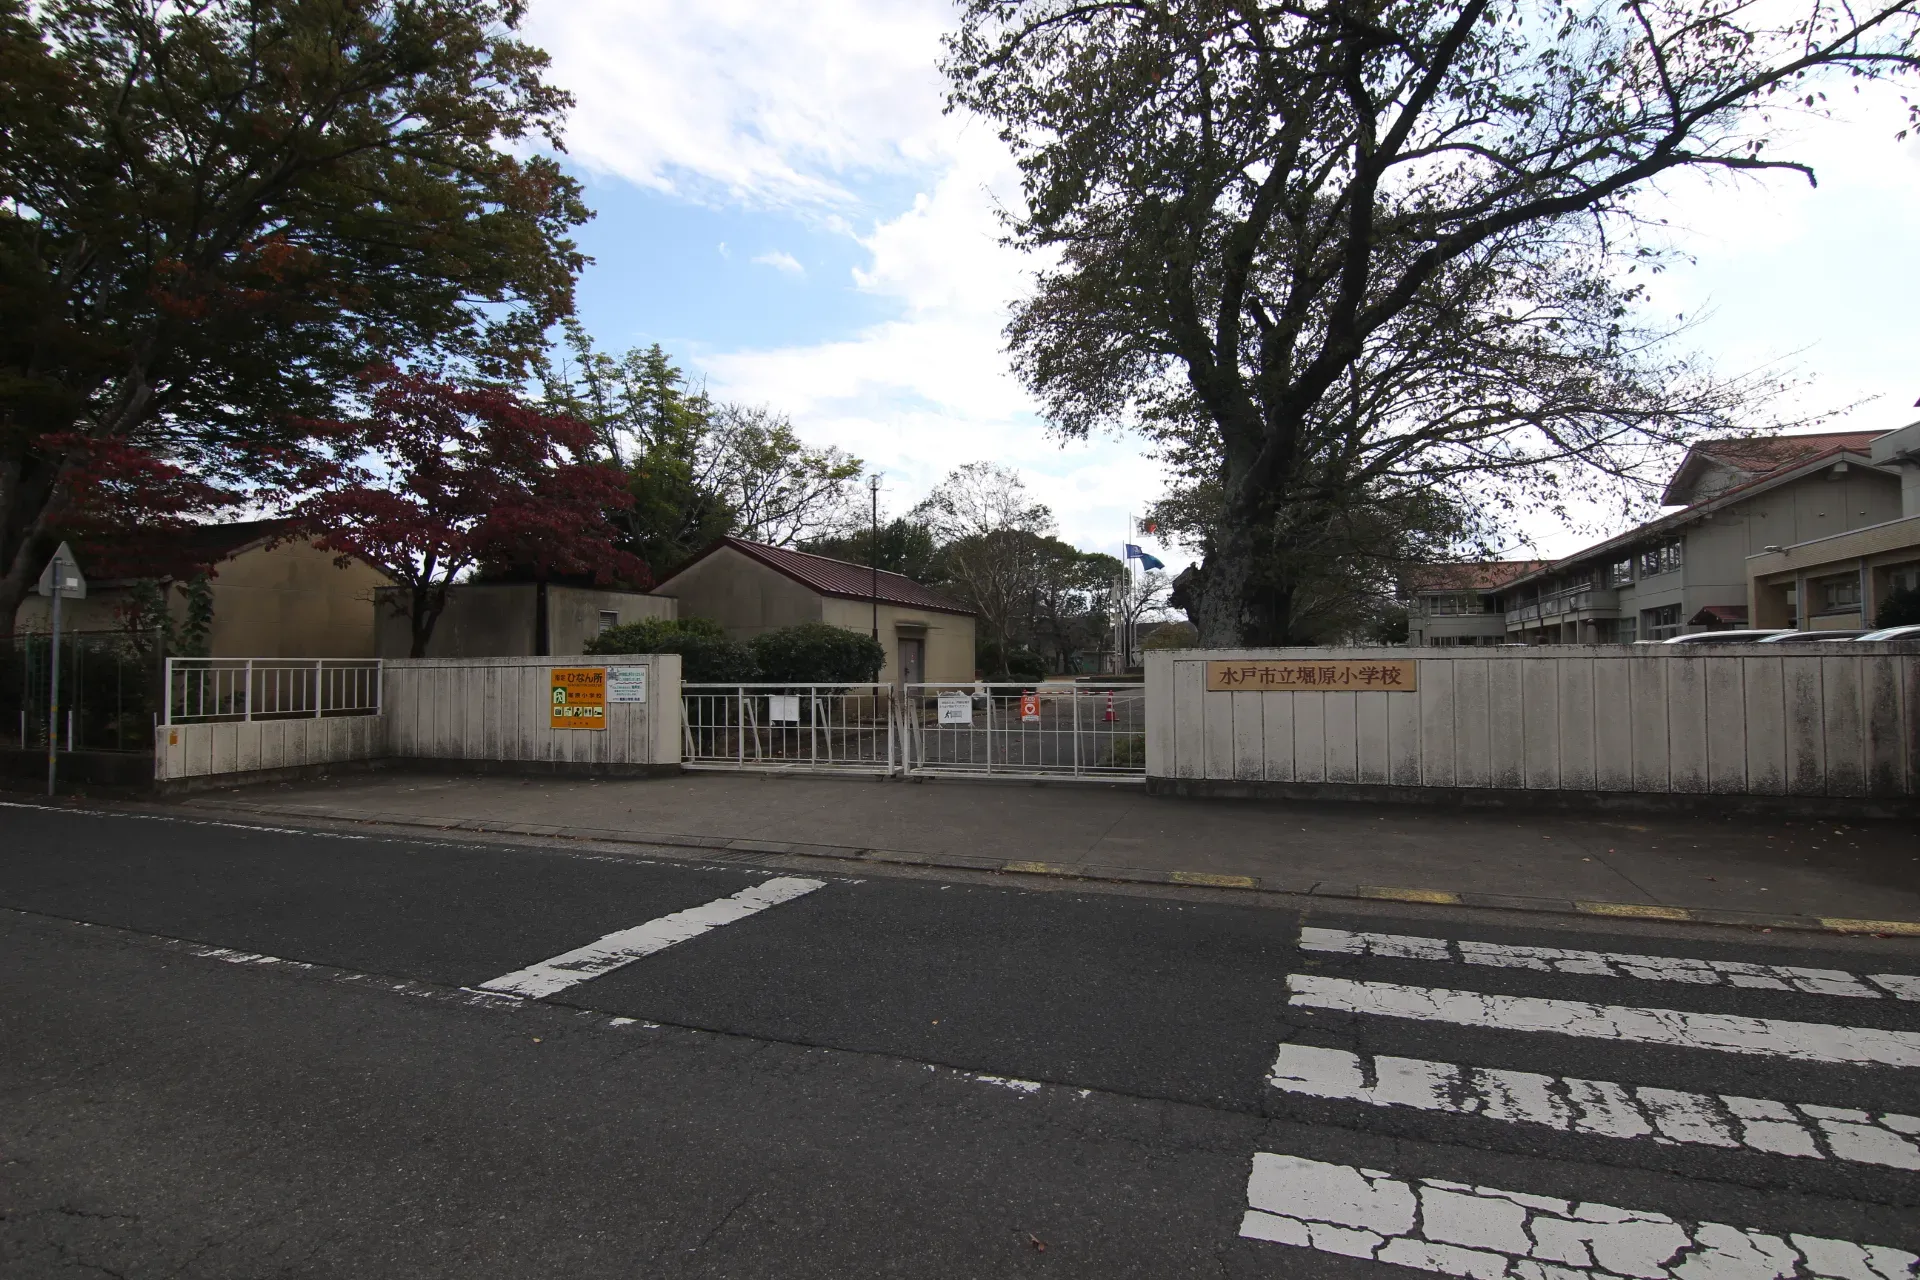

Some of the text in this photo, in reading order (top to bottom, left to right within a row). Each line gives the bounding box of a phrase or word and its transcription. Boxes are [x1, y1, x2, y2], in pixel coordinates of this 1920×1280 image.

[567, 673, 602, 683] ひなん所
[1219, 665, 1402, 685] 水戸市立堀原小学校
